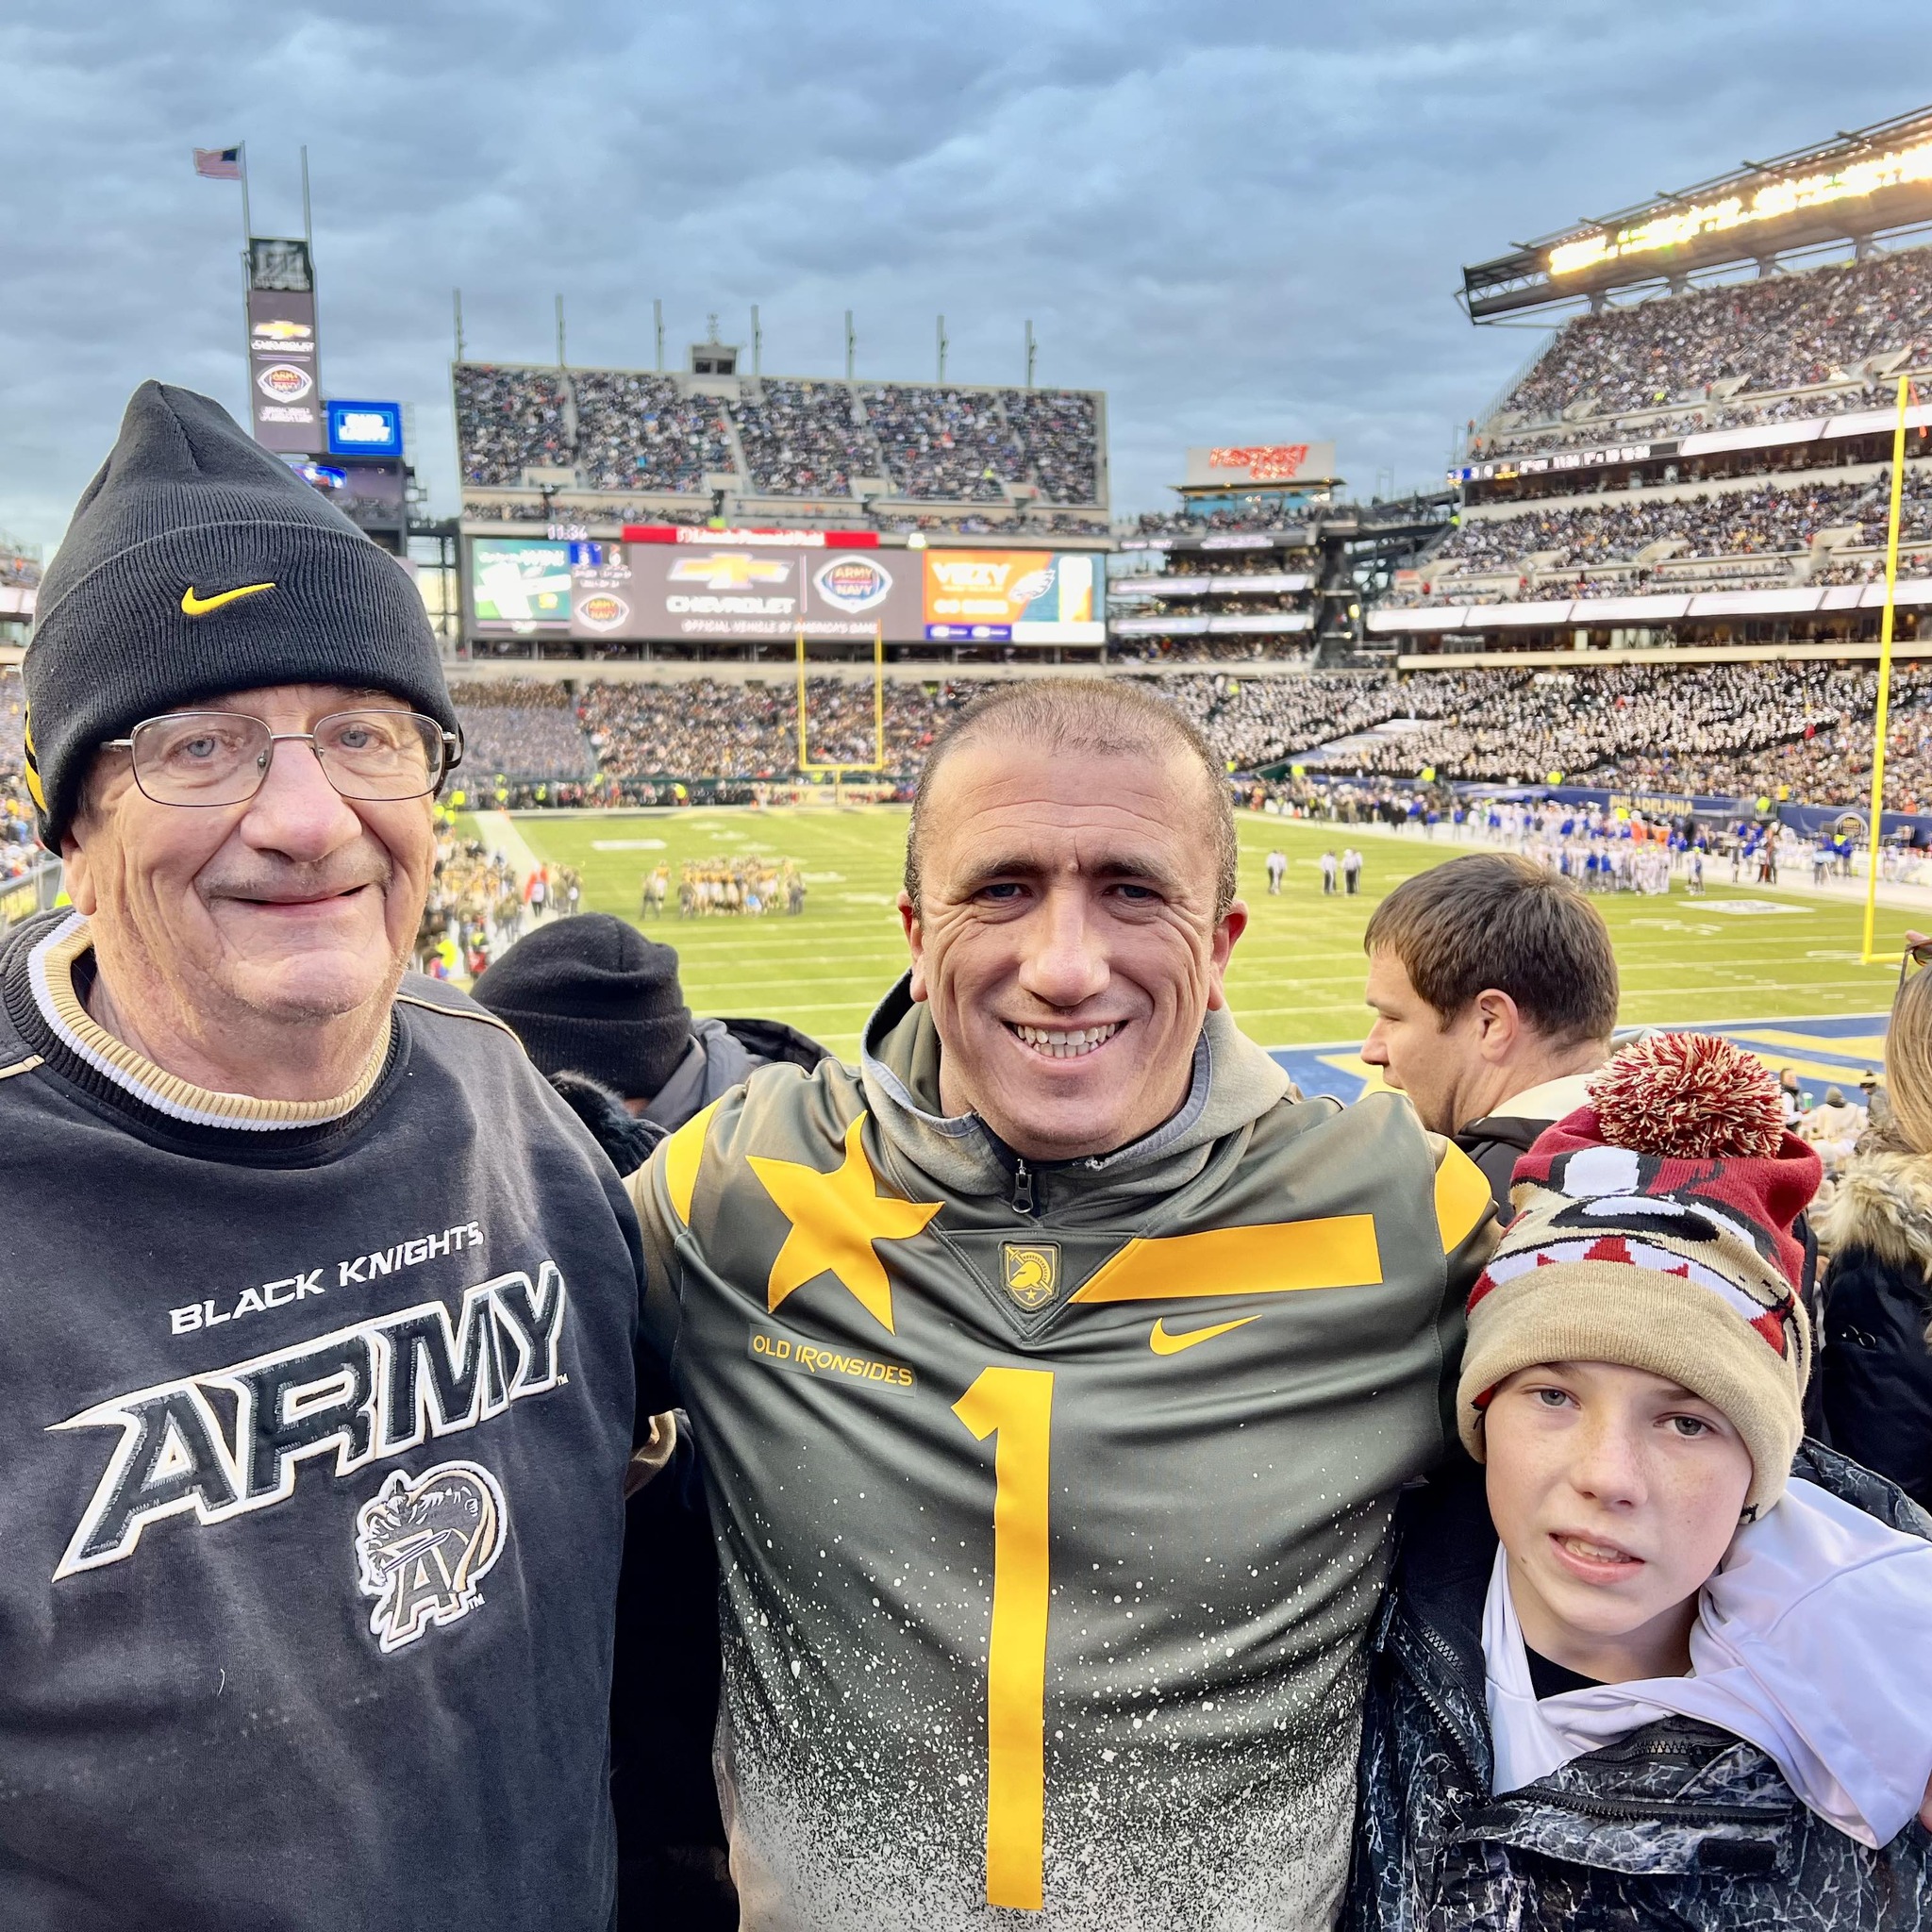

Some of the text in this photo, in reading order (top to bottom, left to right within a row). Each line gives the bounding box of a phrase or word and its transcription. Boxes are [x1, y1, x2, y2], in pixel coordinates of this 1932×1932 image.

[835, 566, 874, 579] ARMY
[835, 584, 874, 596] NAVY
[666, 595, 796, 614] CHEVROLET
[681, 618, 731, 633] OFFICIAL
[1609, 793, 1693, 817] PHILADELPHIA
[170, 1221, 485, 1335] BLACK KNIGHTS
[753, 1335, 913, 1387] OLD IRONSIDES
[44, 1260, 566, 1582] ARMY
[950, 1366, 1055, 1910] 1
